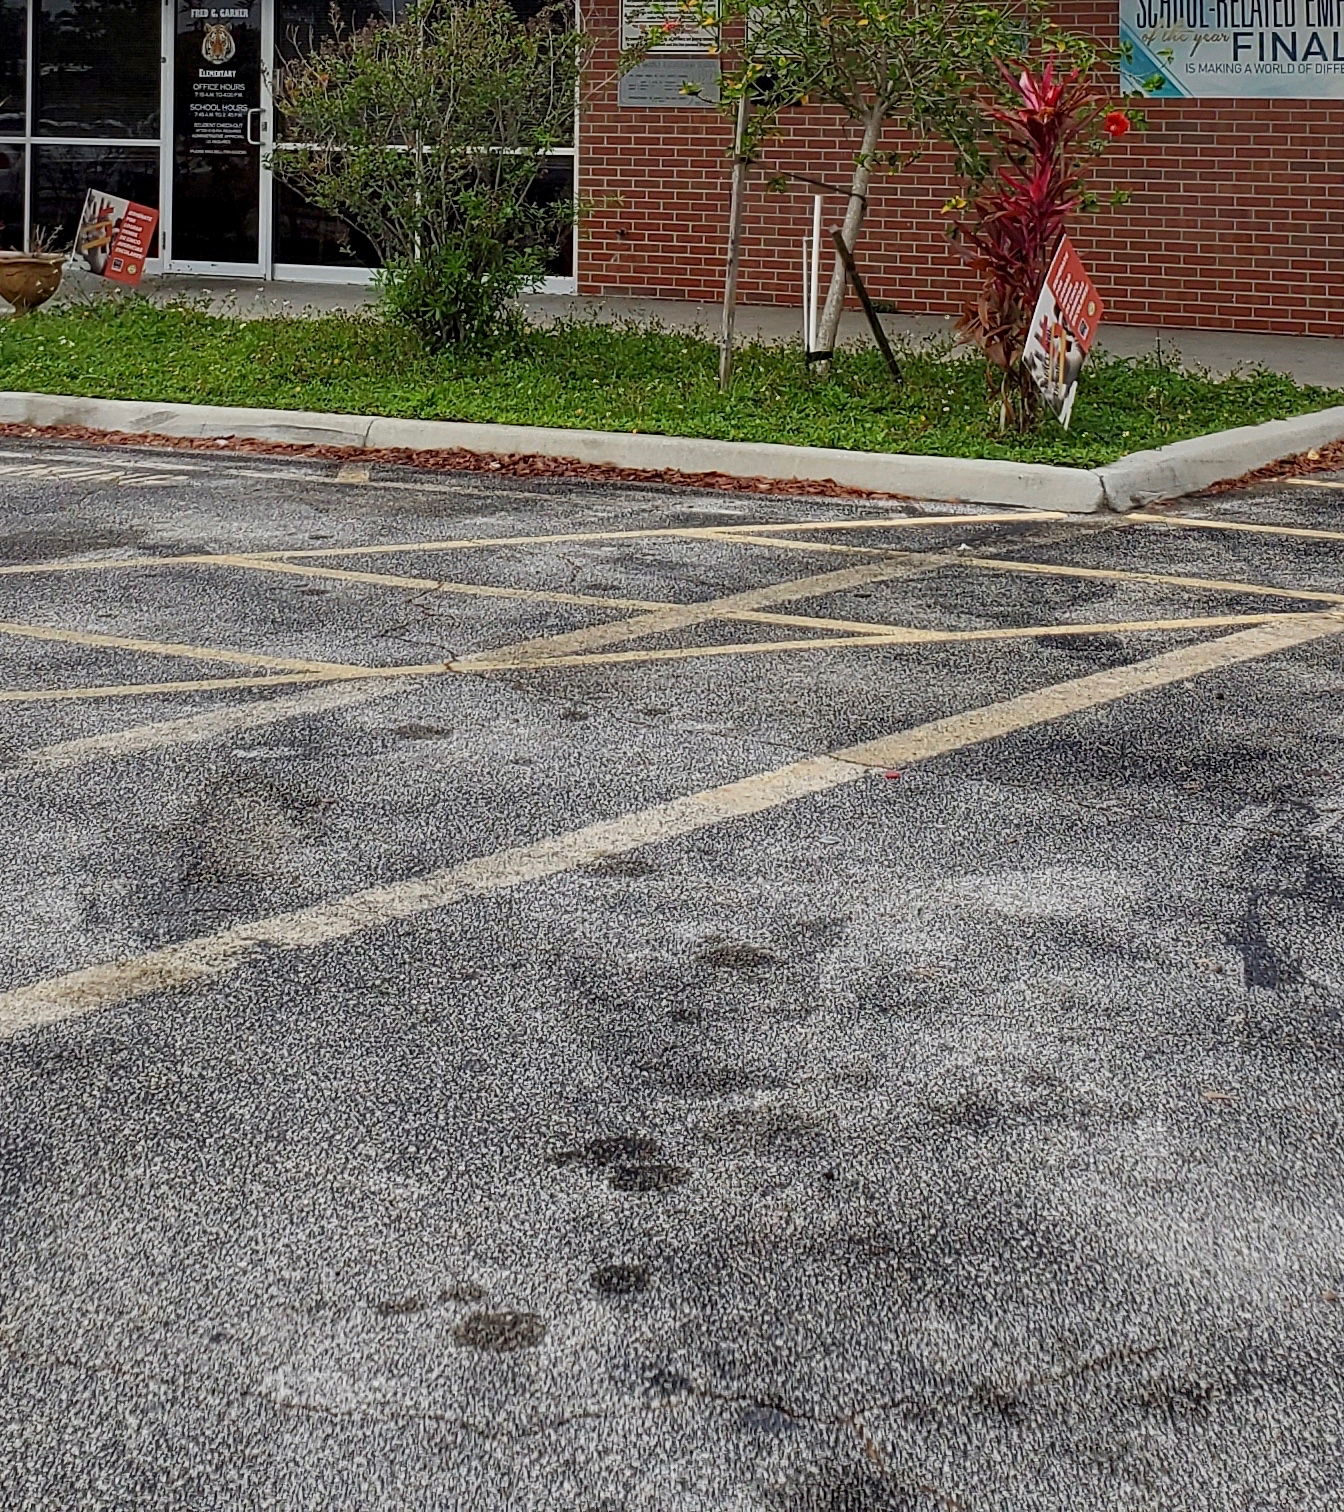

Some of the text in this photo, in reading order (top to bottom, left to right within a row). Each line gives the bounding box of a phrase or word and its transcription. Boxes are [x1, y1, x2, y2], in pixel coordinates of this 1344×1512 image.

[190, 8, 209, 18] FRED
[1141, 29, 1156, 47] of
[1192, 33, 1230, 58] year
[1185, 63, 1196, 74] IS
[1197, 63, 1243, 74] MAKING
[1244, 63, 1253, 74] A
[1253, 63, 1295, 74] WORLD
[1297, 63, 1312, 74] OF
[193, 83, 246, 91] OFFICE HOURS
[189, 103, 248, 112] SCHOOL HOURS
